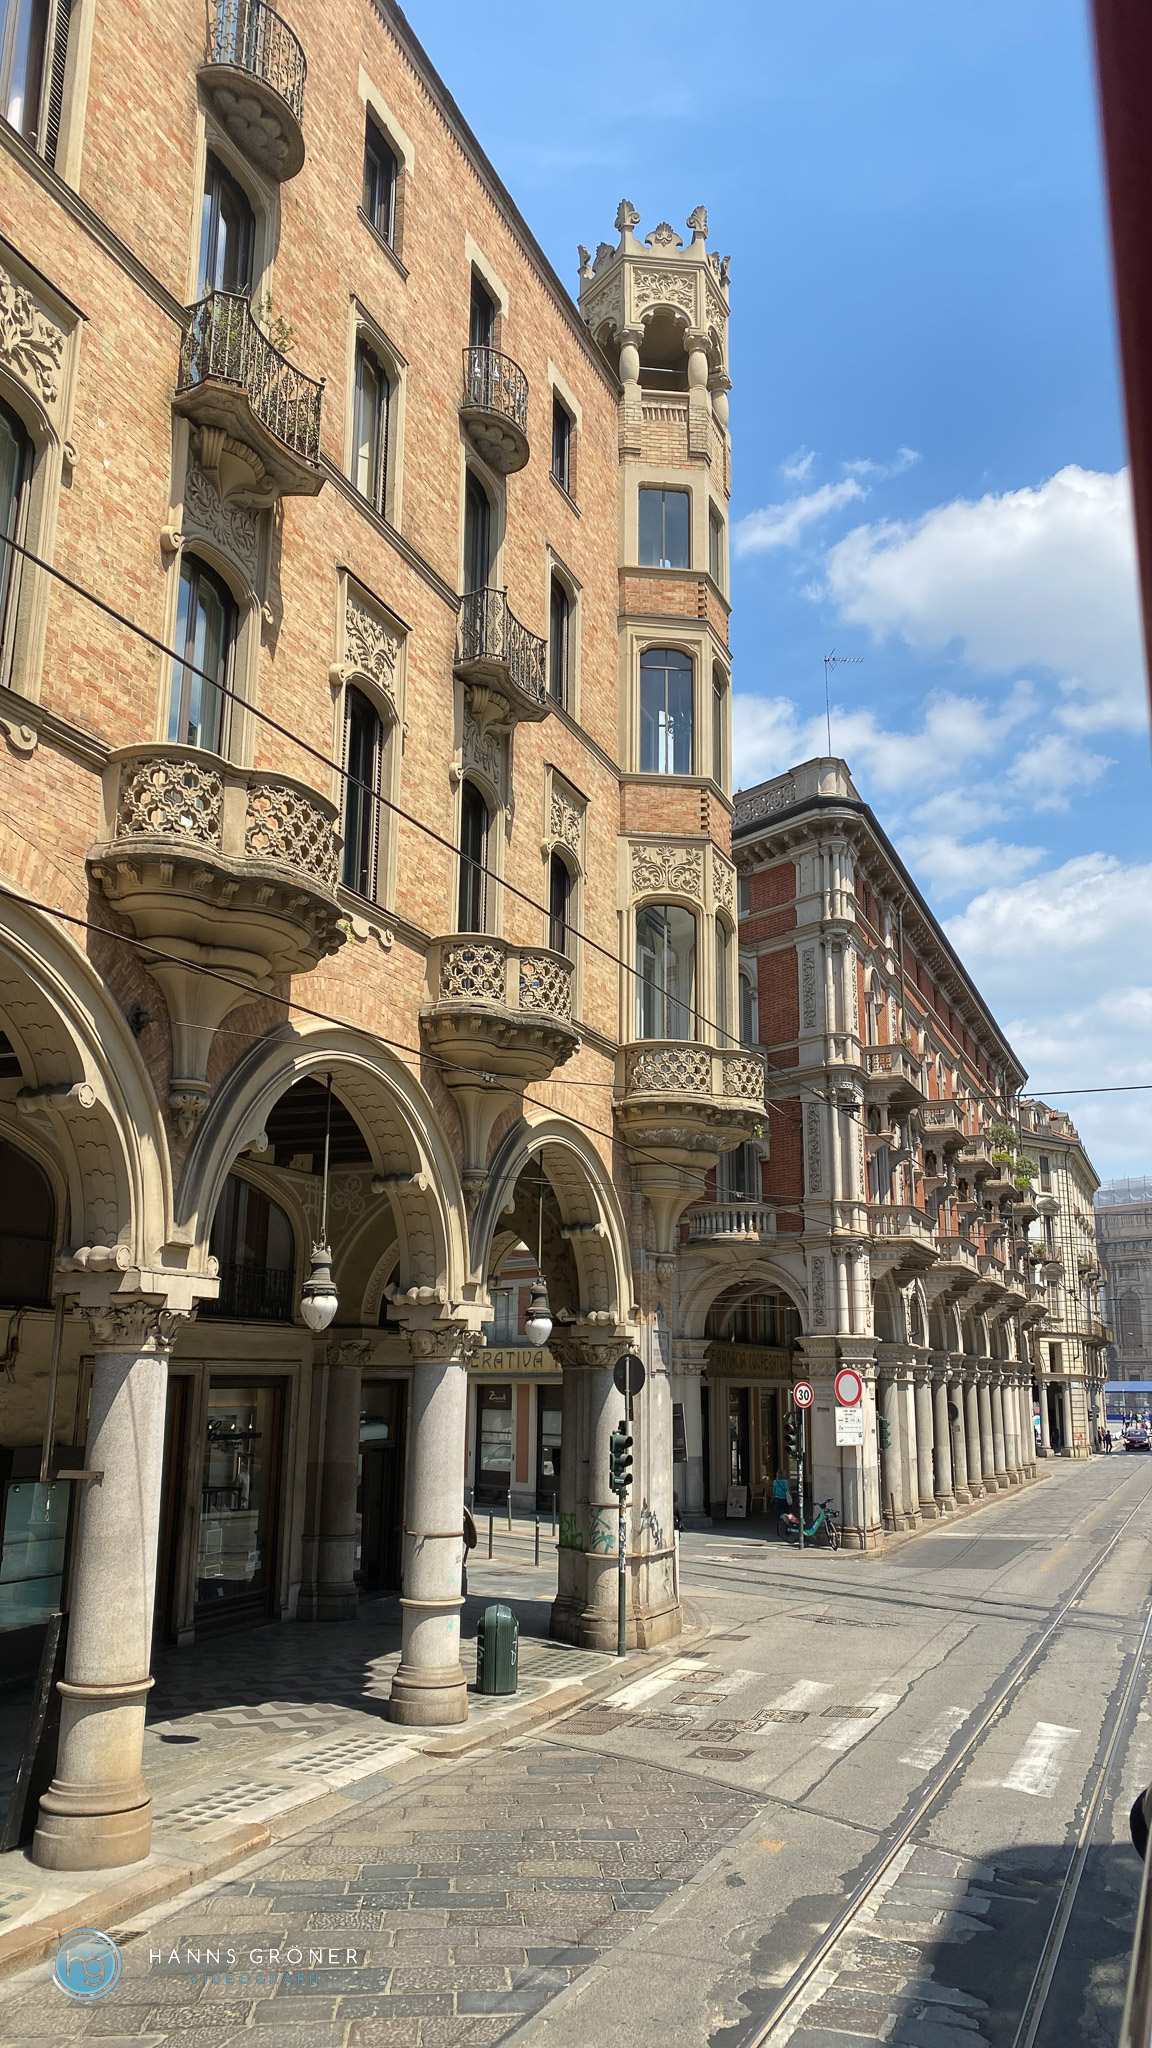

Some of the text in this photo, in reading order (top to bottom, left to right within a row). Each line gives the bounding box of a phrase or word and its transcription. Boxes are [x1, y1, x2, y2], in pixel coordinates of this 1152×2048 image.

[711, 1349, 789, 1372] FARMACIA COOPERATIVA
[798, 1389, 810, 1401] 30
